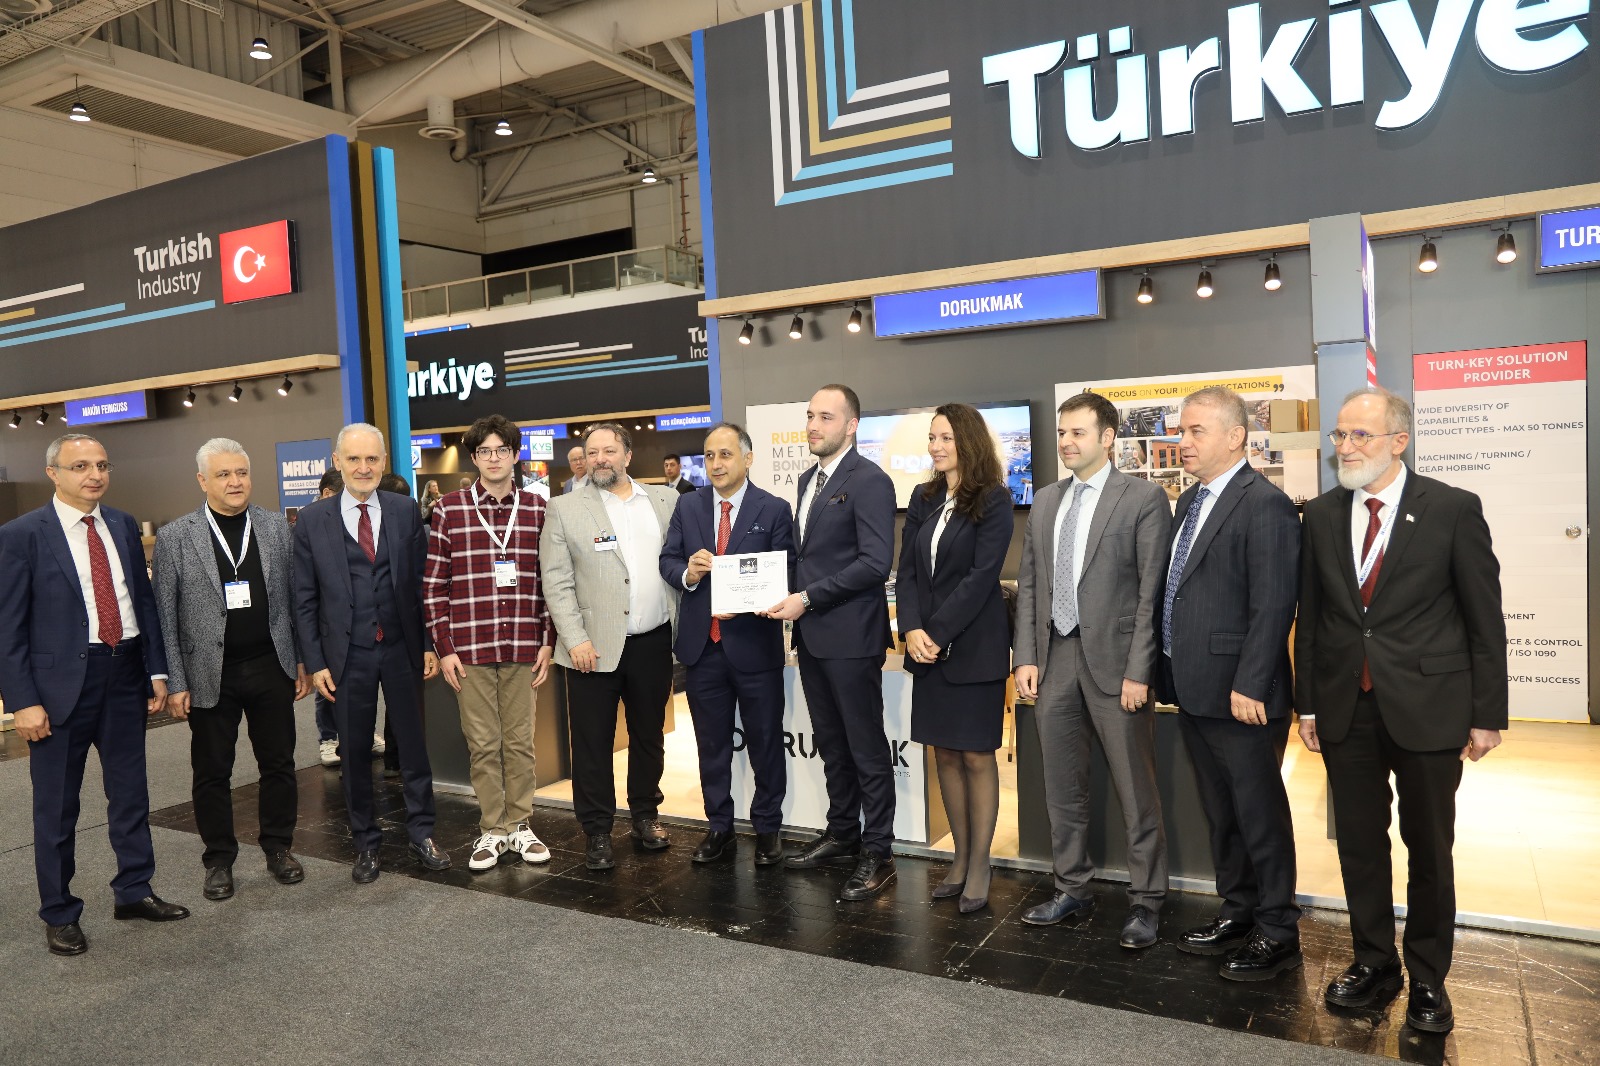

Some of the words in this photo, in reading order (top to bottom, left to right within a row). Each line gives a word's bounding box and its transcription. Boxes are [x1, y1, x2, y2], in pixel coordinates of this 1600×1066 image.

[982, 0, 1590, 160] Türkiye
[1554, 225, 1600, 248] TUR
[134, 232, 212, 273] Turkish
[137, 271, 201, 300] Industry
[940, 292, 1024, 317] DORUKMAK
[688, 326, 708, 343] Tu
[1428, 356, 1494, 371] TURN-KEY
[1496, 350, 1568, 366] SOLUTION
[1463, 368, 1531, 382] PROVIDER
[1108, 390, 1137, 398] FOCUS
[1417, 406, 1442, 414] WIDE
[1444, 404, 1494, 413] DIVERSITY
[1417, 416, 1480, 426] CAPABILITIES
[1418, 428, 1462, 436] PRODUCT
[1465, 426, 1494, 434] TYPES
[1542, 422, 1584, 430] TONNES
[532, 442, 552, 451] KYS
[772, 445, 811, 458] MET
[1418, 453, 1472, 461] MACHINING
[1474, 452, 1478, 460] /
[1481, 450, 1525, 459] TURNING
[1527, 450, 1531, 458] /
[1446, 463, 1491, 472] HOBBING
[773, 473, 802, 486] PA
[1534, 638, 1583, 647] CONTROL
[1535, 676, 1581, 684] SUCCESS
